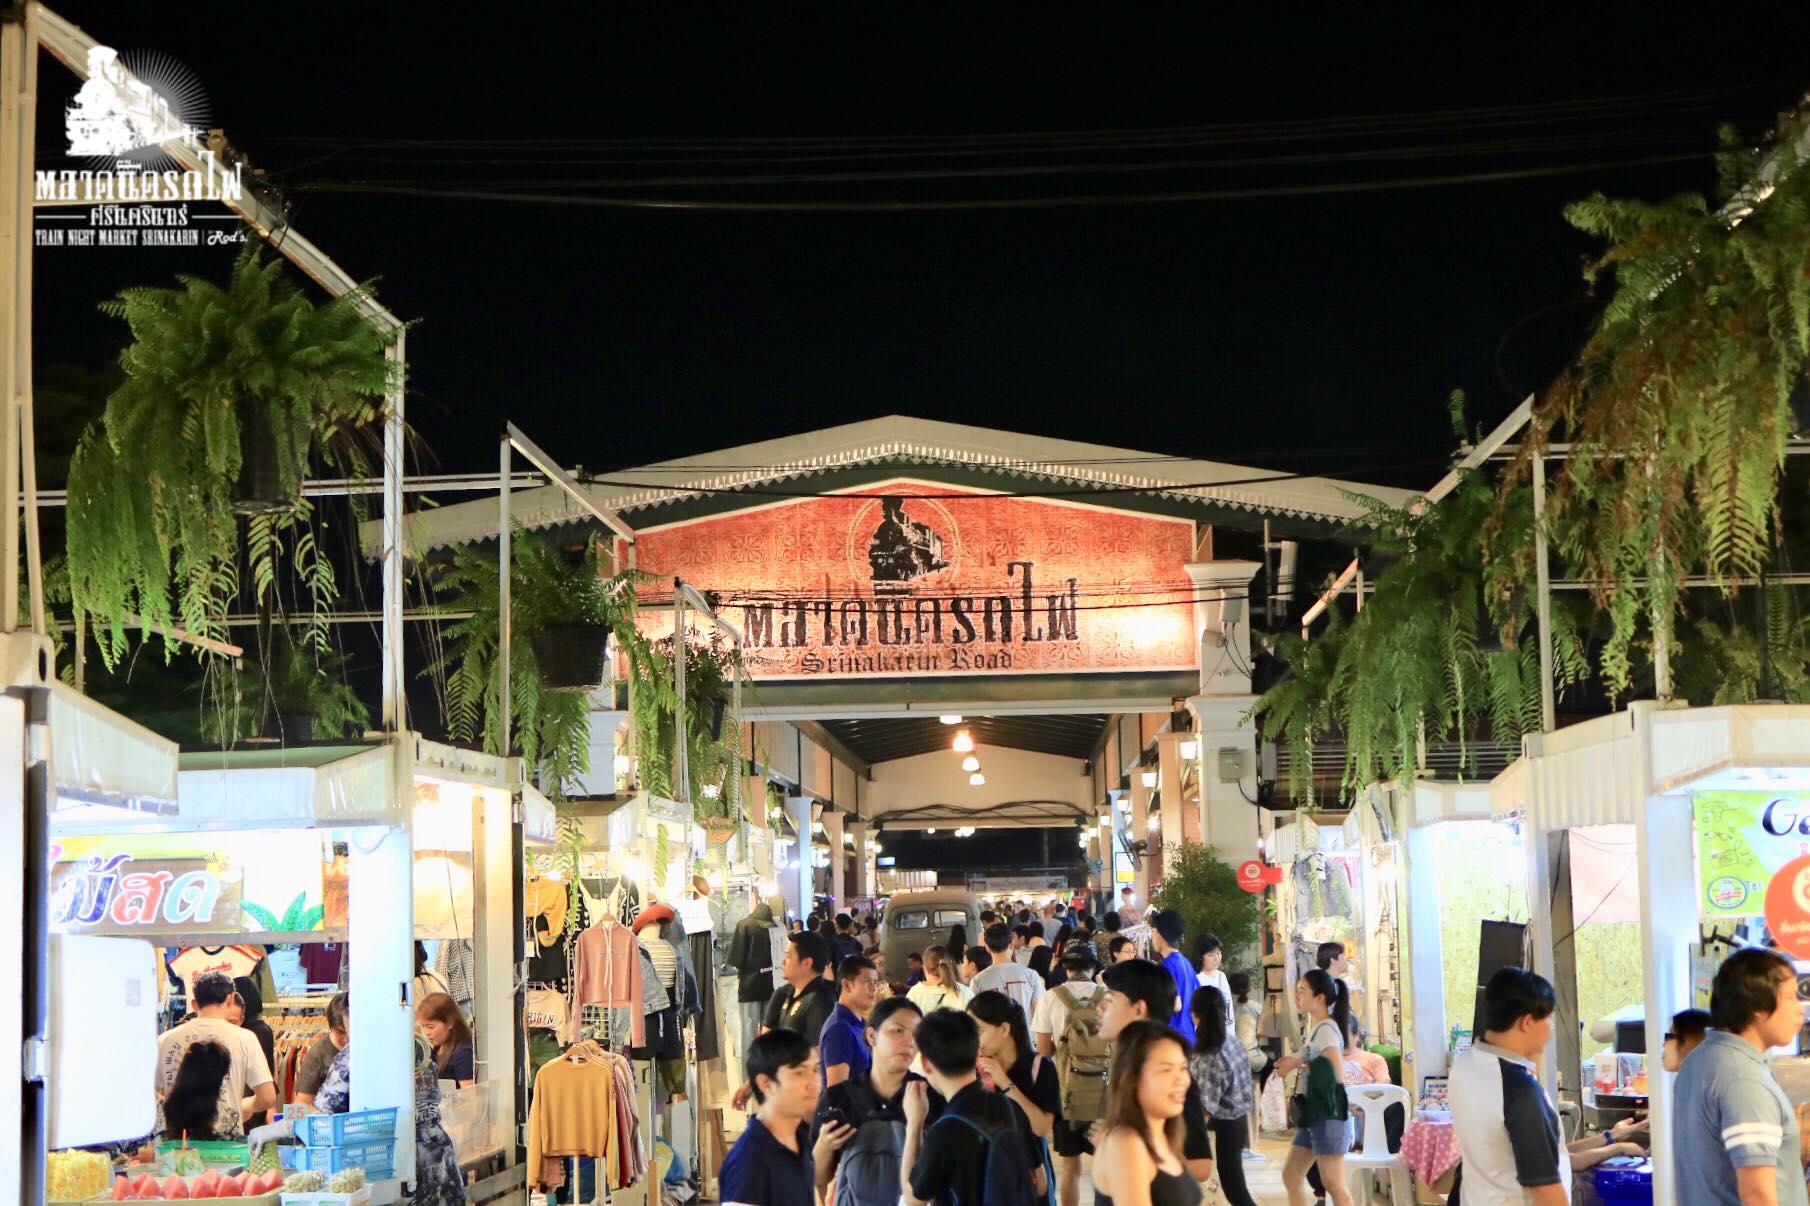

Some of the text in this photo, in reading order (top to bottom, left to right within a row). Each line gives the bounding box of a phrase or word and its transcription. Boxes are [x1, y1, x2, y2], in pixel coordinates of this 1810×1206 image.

[801, 652, 939, 674] Srinakarin
[950, 648, 1013, 670] Road
[287, 1107, 304, 1120] 25
